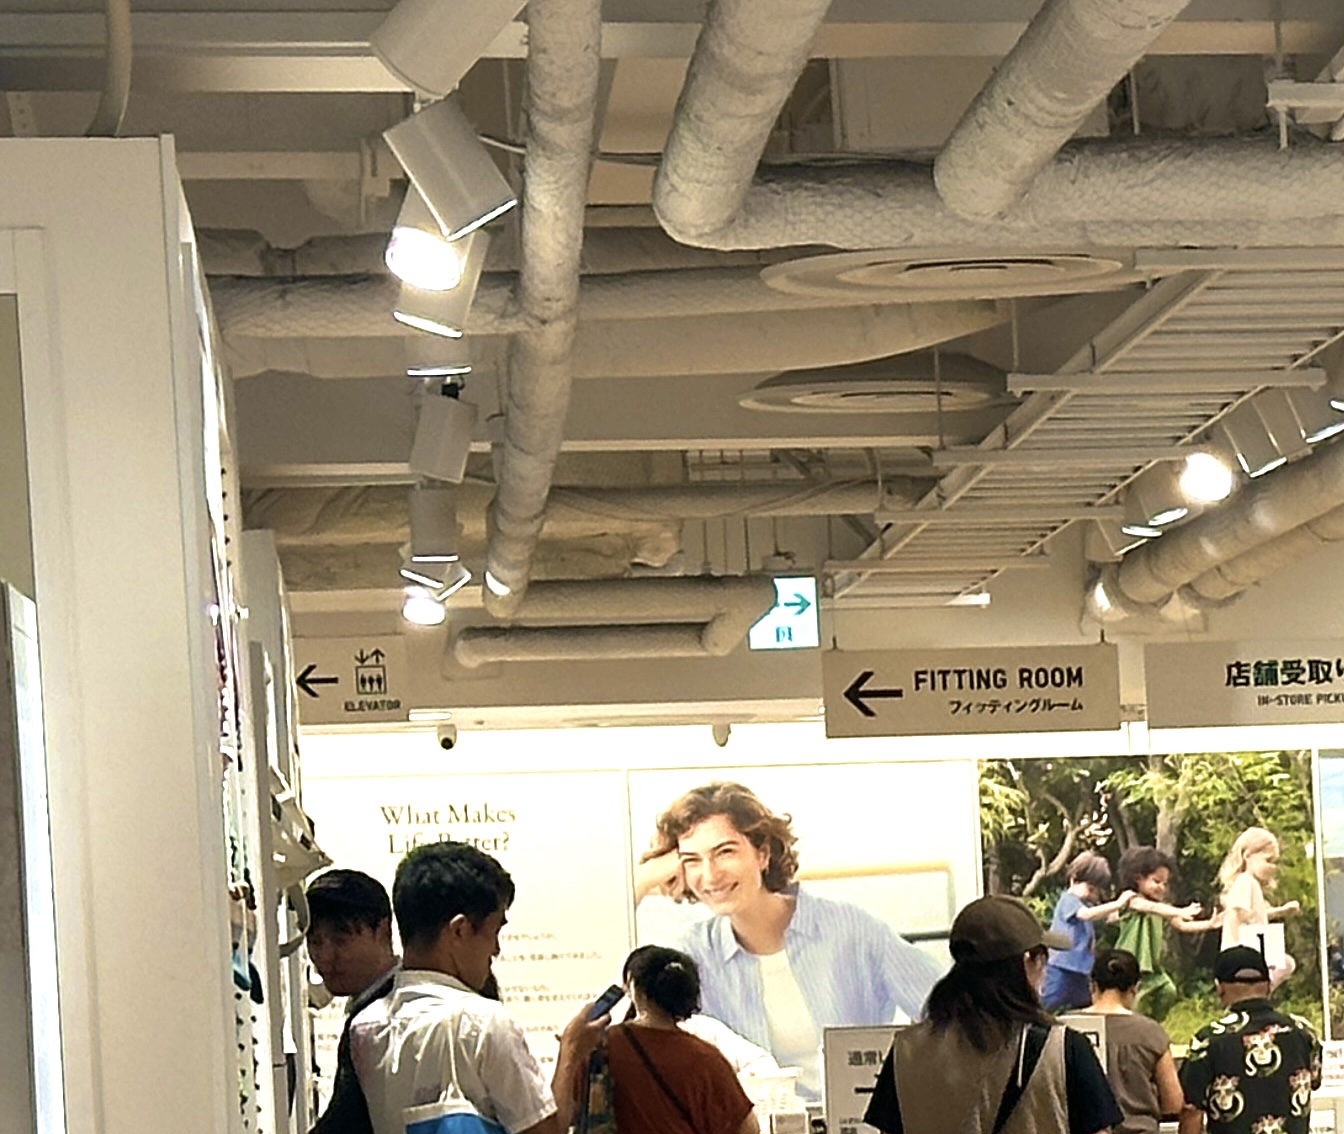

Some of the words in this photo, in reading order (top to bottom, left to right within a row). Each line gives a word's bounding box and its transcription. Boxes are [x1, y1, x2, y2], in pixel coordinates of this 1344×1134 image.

[914, 668, 1007, 692] FITTING
[1018, 666, 1083, 688] ROOM
[344, 700, 401, 712] ELEVATOR
[949, 698, 1083, 715] フィッティングルーム
[1257, 693, 1313, 706] IN-STORE
[380, 802, 440, 826] What
[447, 802, 517, 824] Makes
